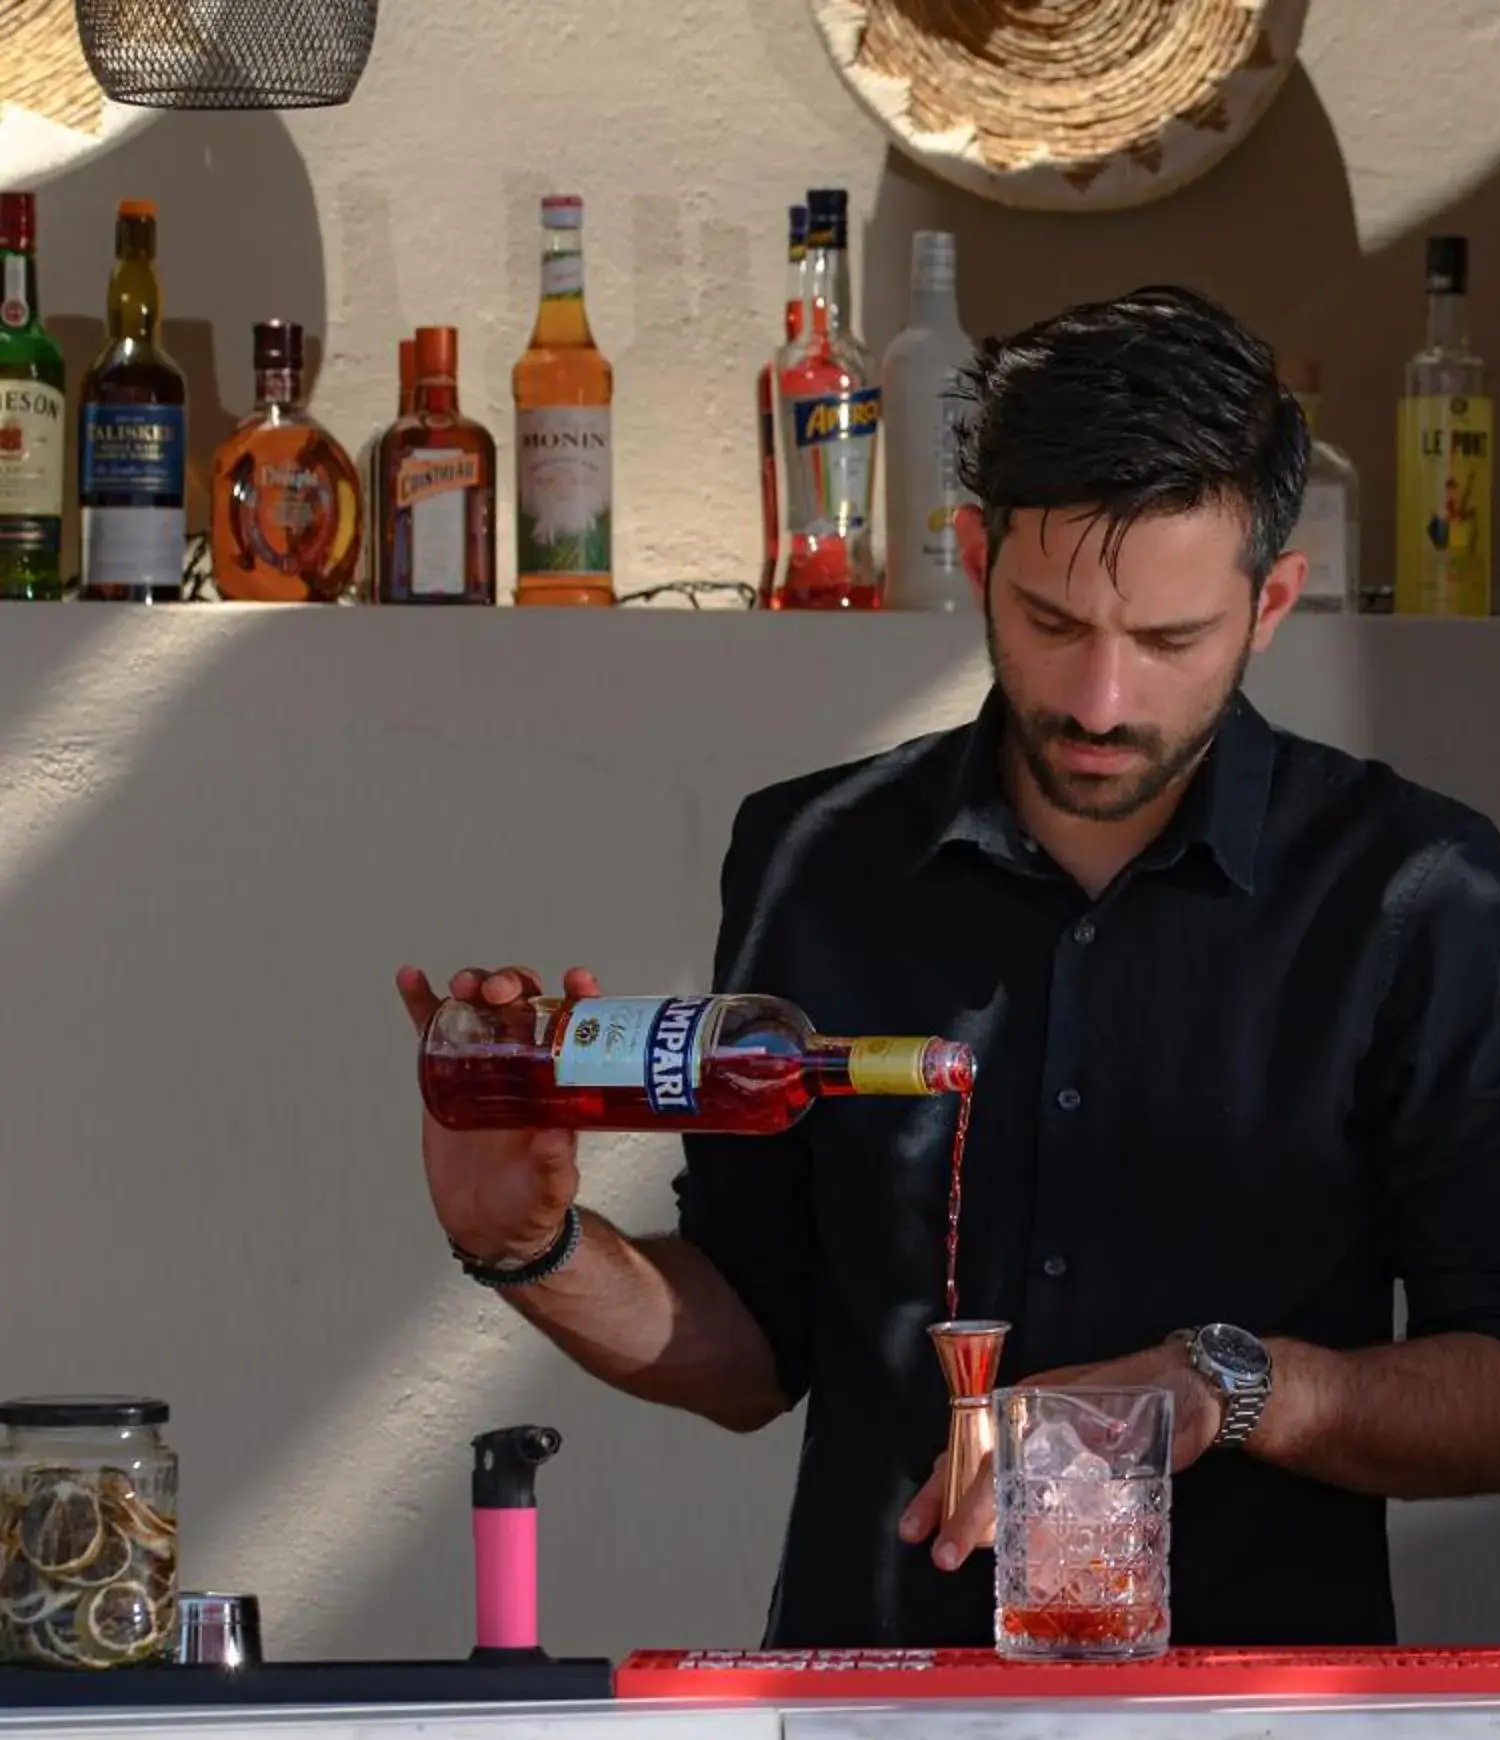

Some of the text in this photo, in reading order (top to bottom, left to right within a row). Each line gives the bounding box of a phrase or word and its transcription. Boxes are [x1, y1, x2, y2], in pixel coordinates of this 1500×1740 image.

[0, 389, 58, 422] ESON
[805, 401, 882, 439] APRO
[522, 432, 605, 449] MONIN
[1422, 429, 1443, 456] LE
